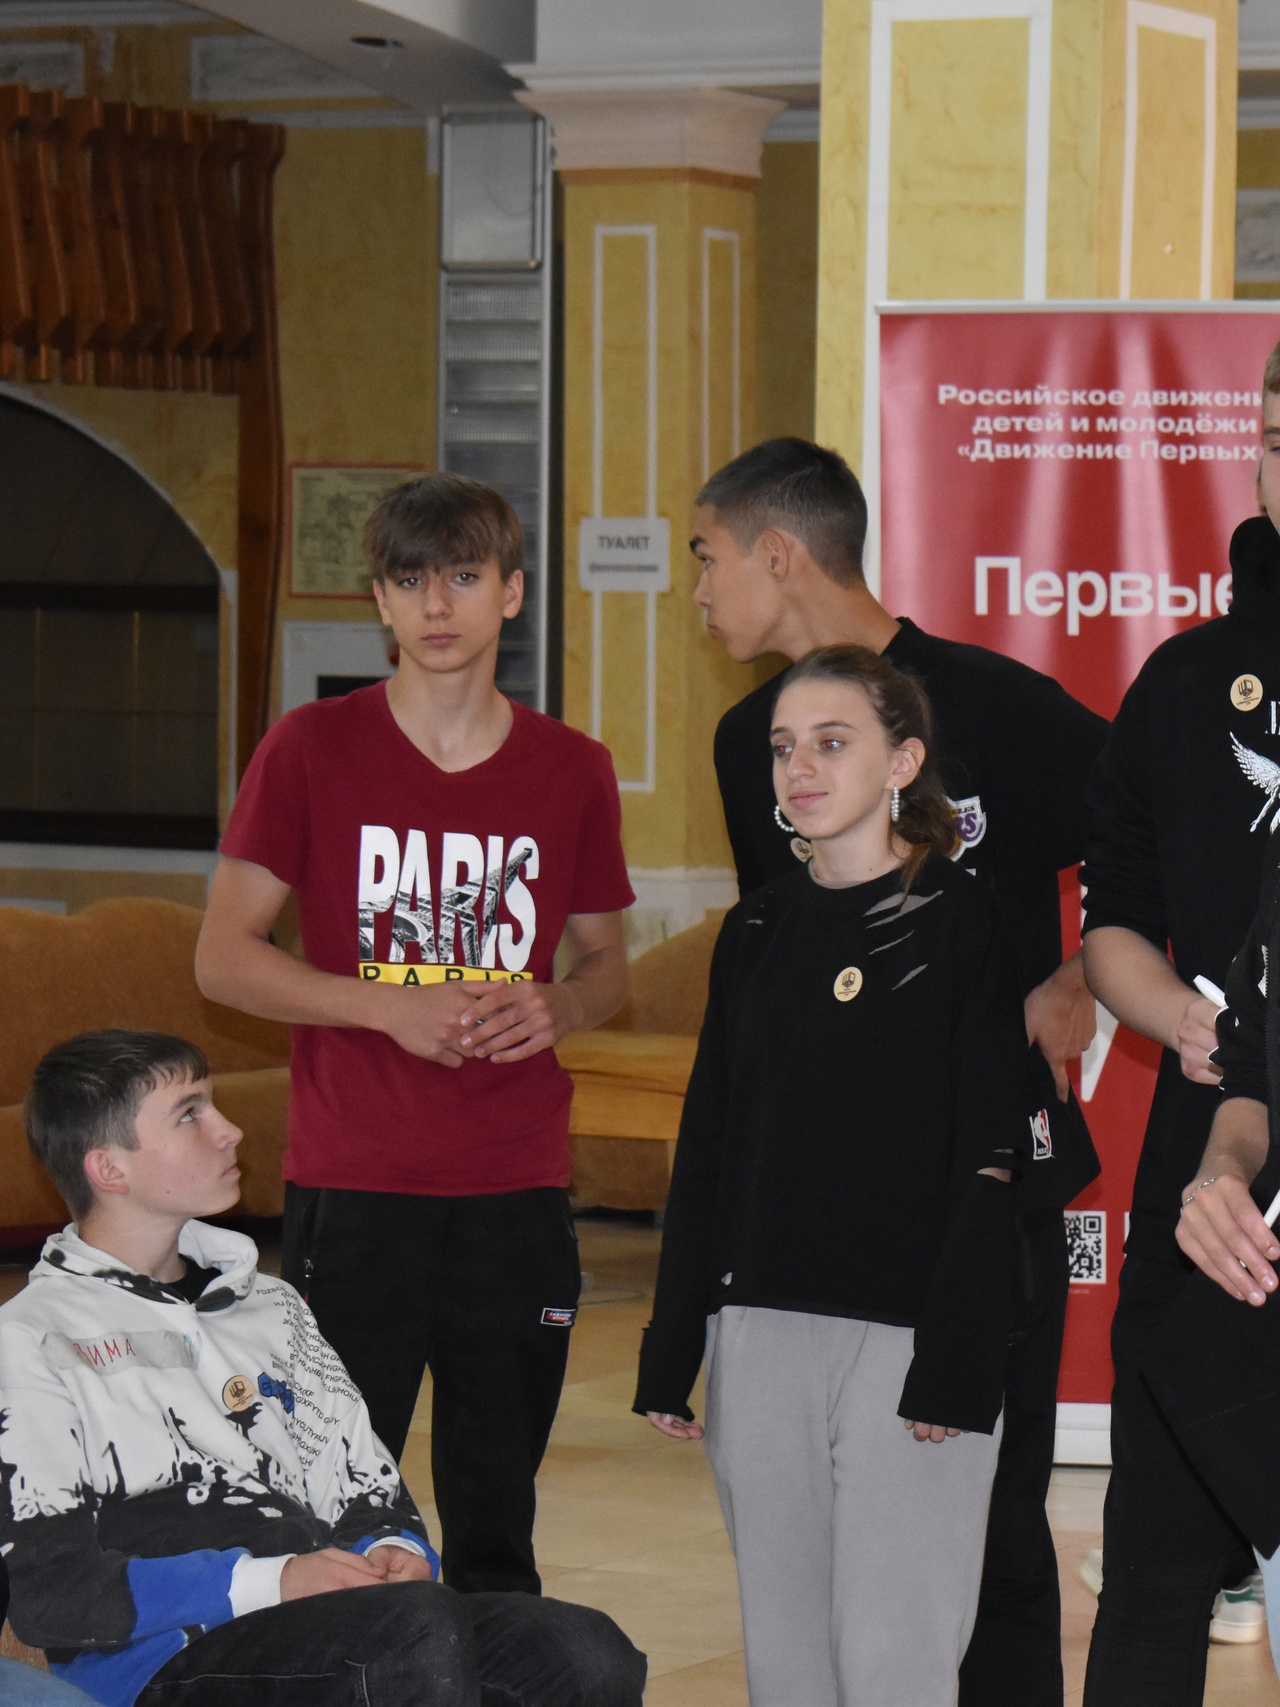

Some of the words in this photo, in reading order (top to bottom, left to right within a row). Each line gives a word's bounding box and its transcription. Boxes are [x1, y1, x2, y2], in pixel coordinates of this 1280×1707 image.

[938, 384, 1125, 406] Российское
[1132, 389, 1263, 408] движени
[972, 412, 1063, 434] детей
[1070, 416, 1089, 432] и
[1097, 413, 1257, 435] молодёжи
[958, 438, 1132, 462] «Движение
[1140, 440, 1263, 464] Первых
[598, 535, 650, 550] ТУАЛЕТ
[358, 825, 540, 972] PARIS
